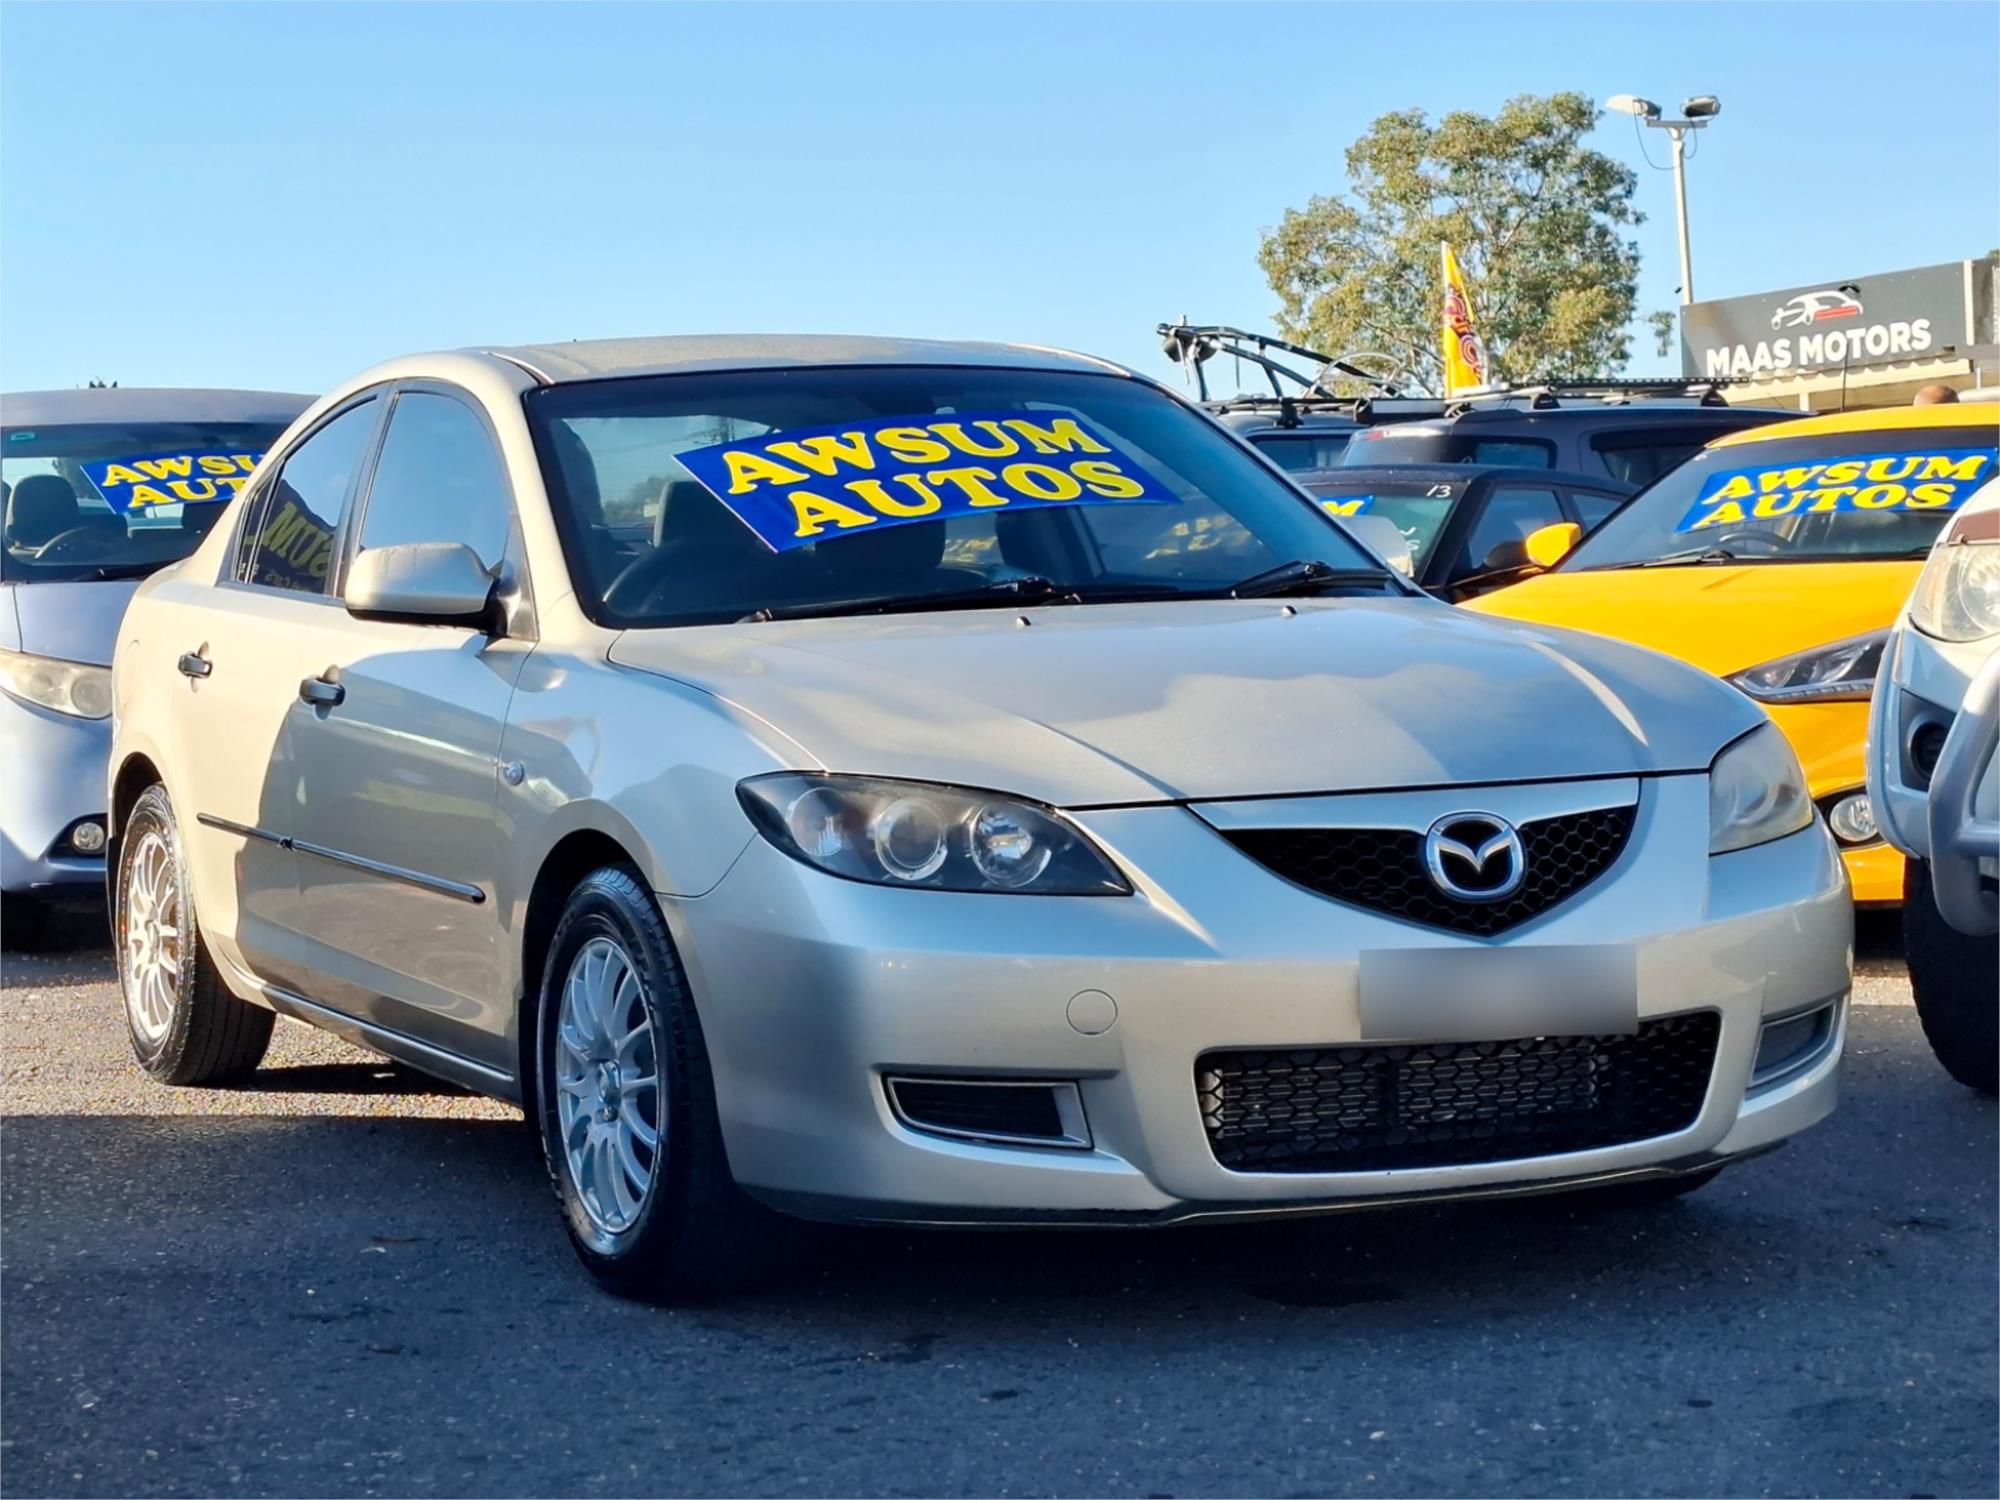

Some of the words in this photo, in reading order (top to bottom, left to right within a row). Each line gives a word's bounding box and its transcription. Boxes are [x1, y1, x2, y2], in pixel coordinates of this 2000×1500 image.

[1706, 338, 1792, 377] MAAS
[1799, 319, 1932, 366] MOTORS
[722, 418, 1112, 495] AWSUM
[1701, 455, 1988, 505] AWSUM
[787, 460, 1145, 537] AUTOS
[1426, 484, 1452, 499] 13
[1692, 483, 1956, 529] AUTOS
